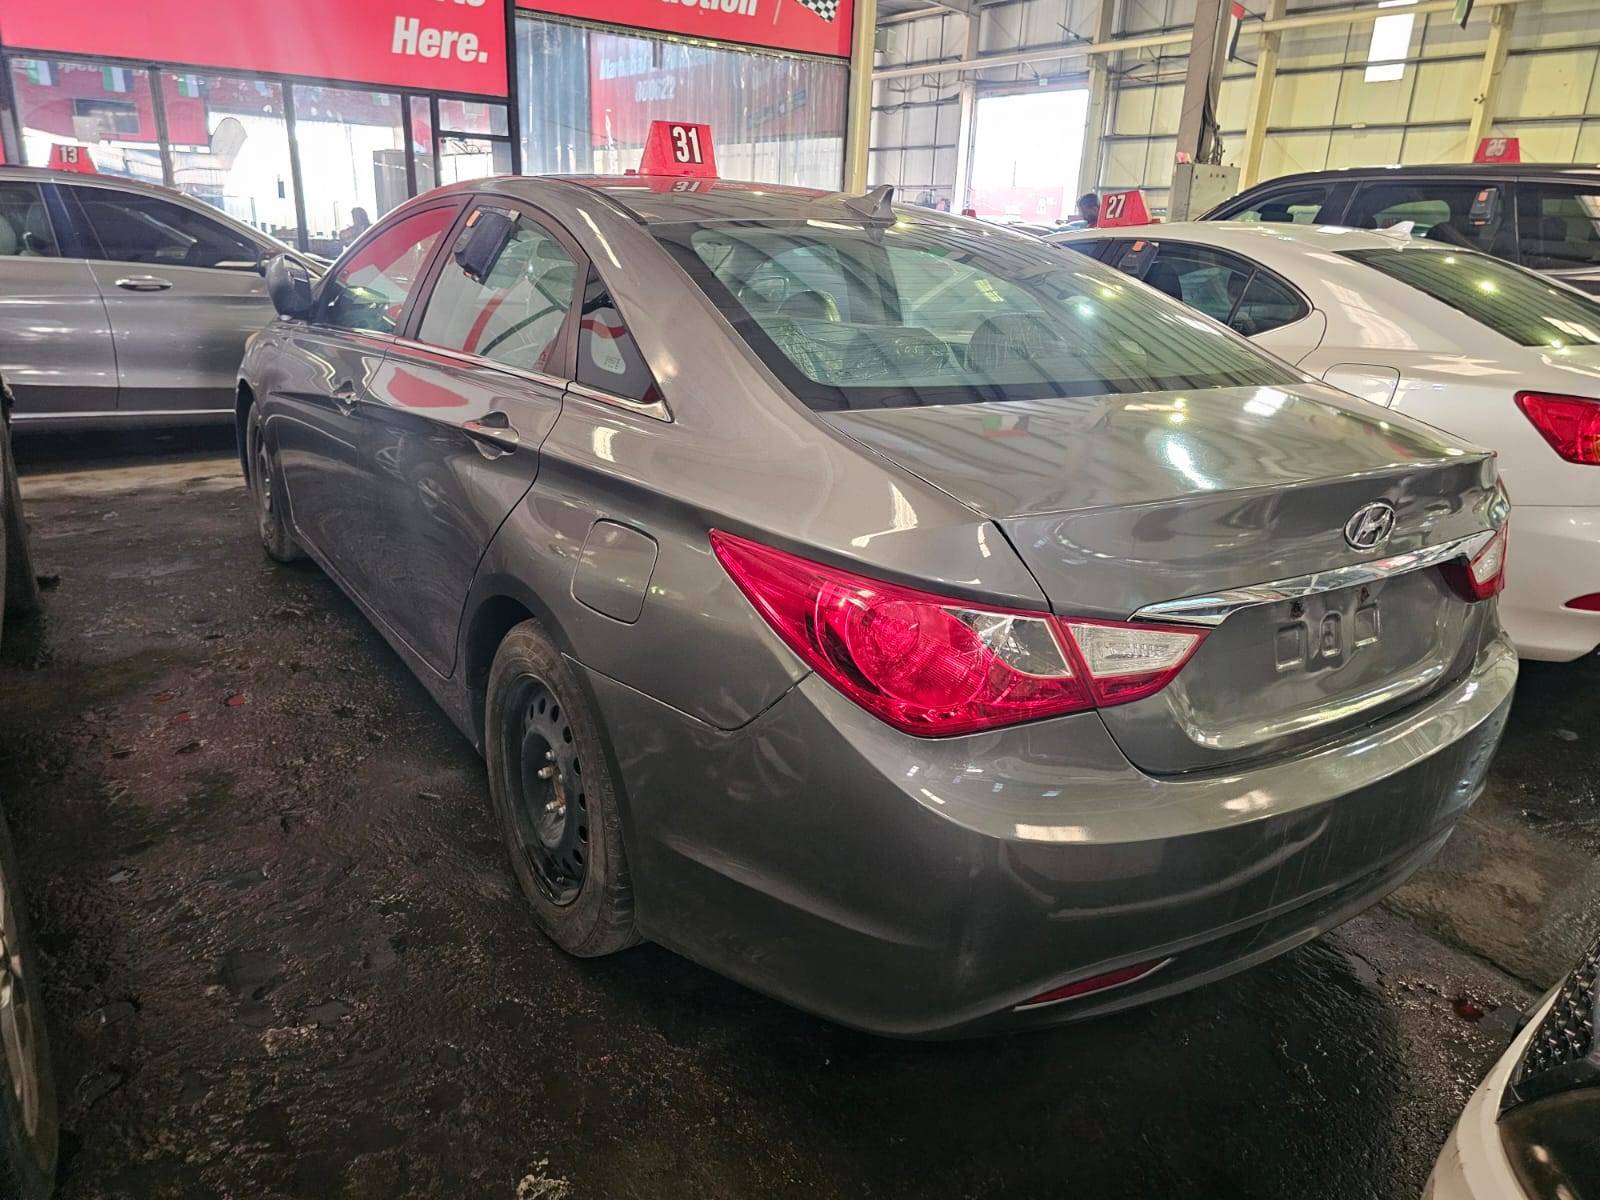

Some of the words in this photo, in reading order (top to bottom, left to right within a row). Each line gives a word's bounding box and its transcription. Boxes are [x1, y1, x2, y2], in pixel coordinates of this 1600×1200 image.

[392, 16, 488, 63] Here.
[60, 145, 78, 163] 13
[672, 126, 702, 163] 31
[1485, 139, 1508, 157] 25
[1106, 194, 1126, 219] 27
